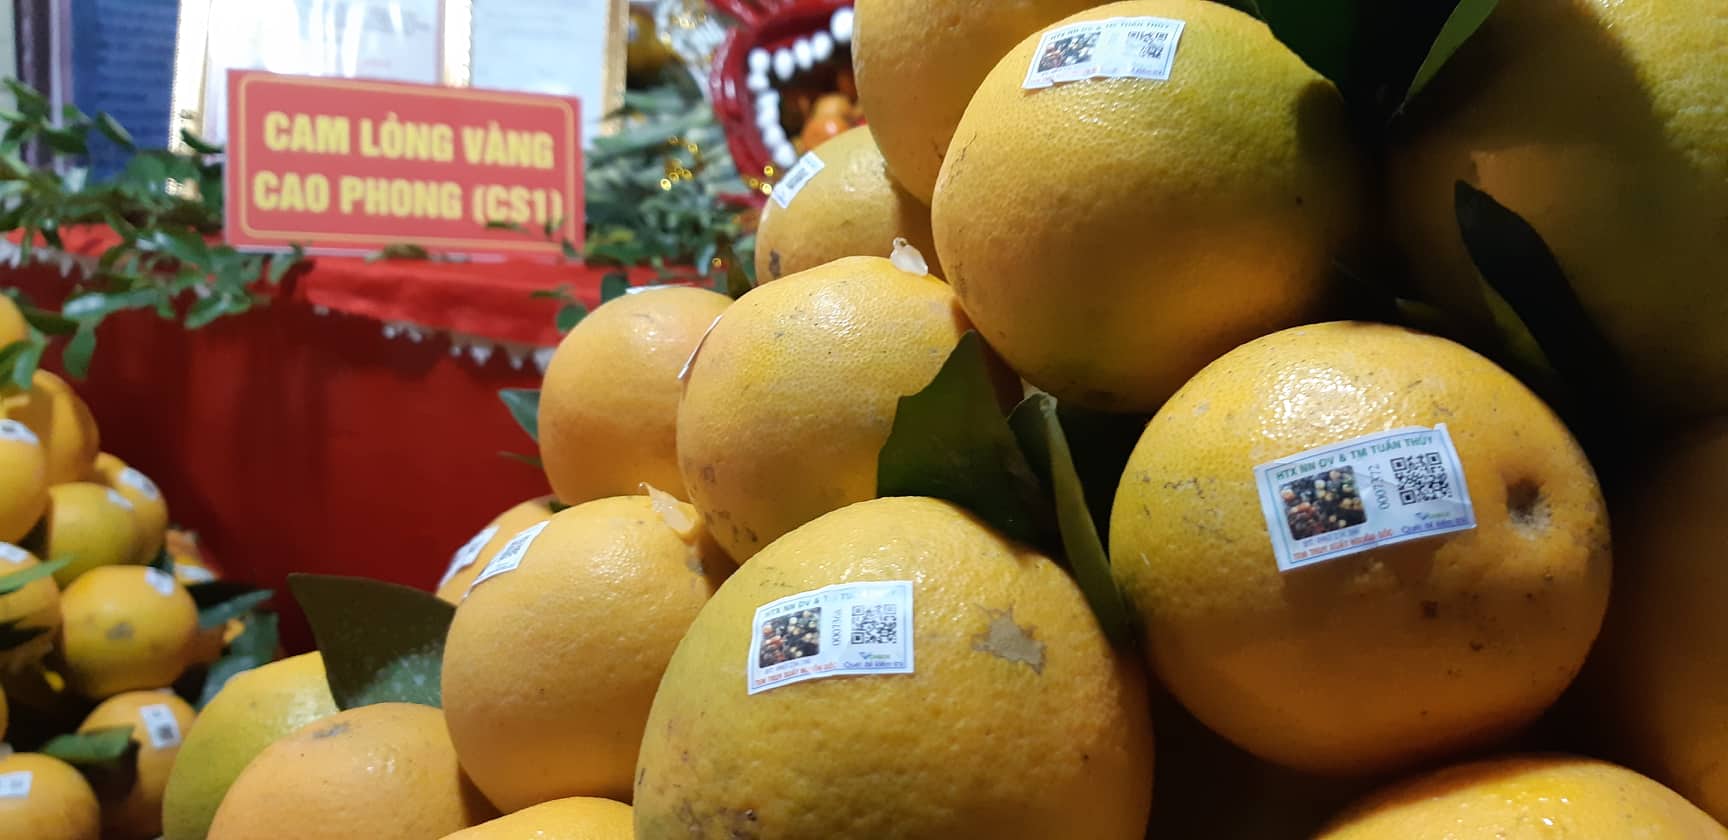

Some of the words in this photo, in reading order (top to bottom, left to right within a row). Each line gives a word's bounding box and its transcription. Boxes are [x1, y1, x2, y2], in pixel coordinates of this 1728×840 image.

[264, 111, 350, 154] CAM
[360, 112, 455, 162] LÒNG
[462, 121, 555, 169] VÀNG
[253, 170, 329, 212] CAO
[339, 175, 463, 220] PHONG
[472, 183, 563, 229] (CS1)
